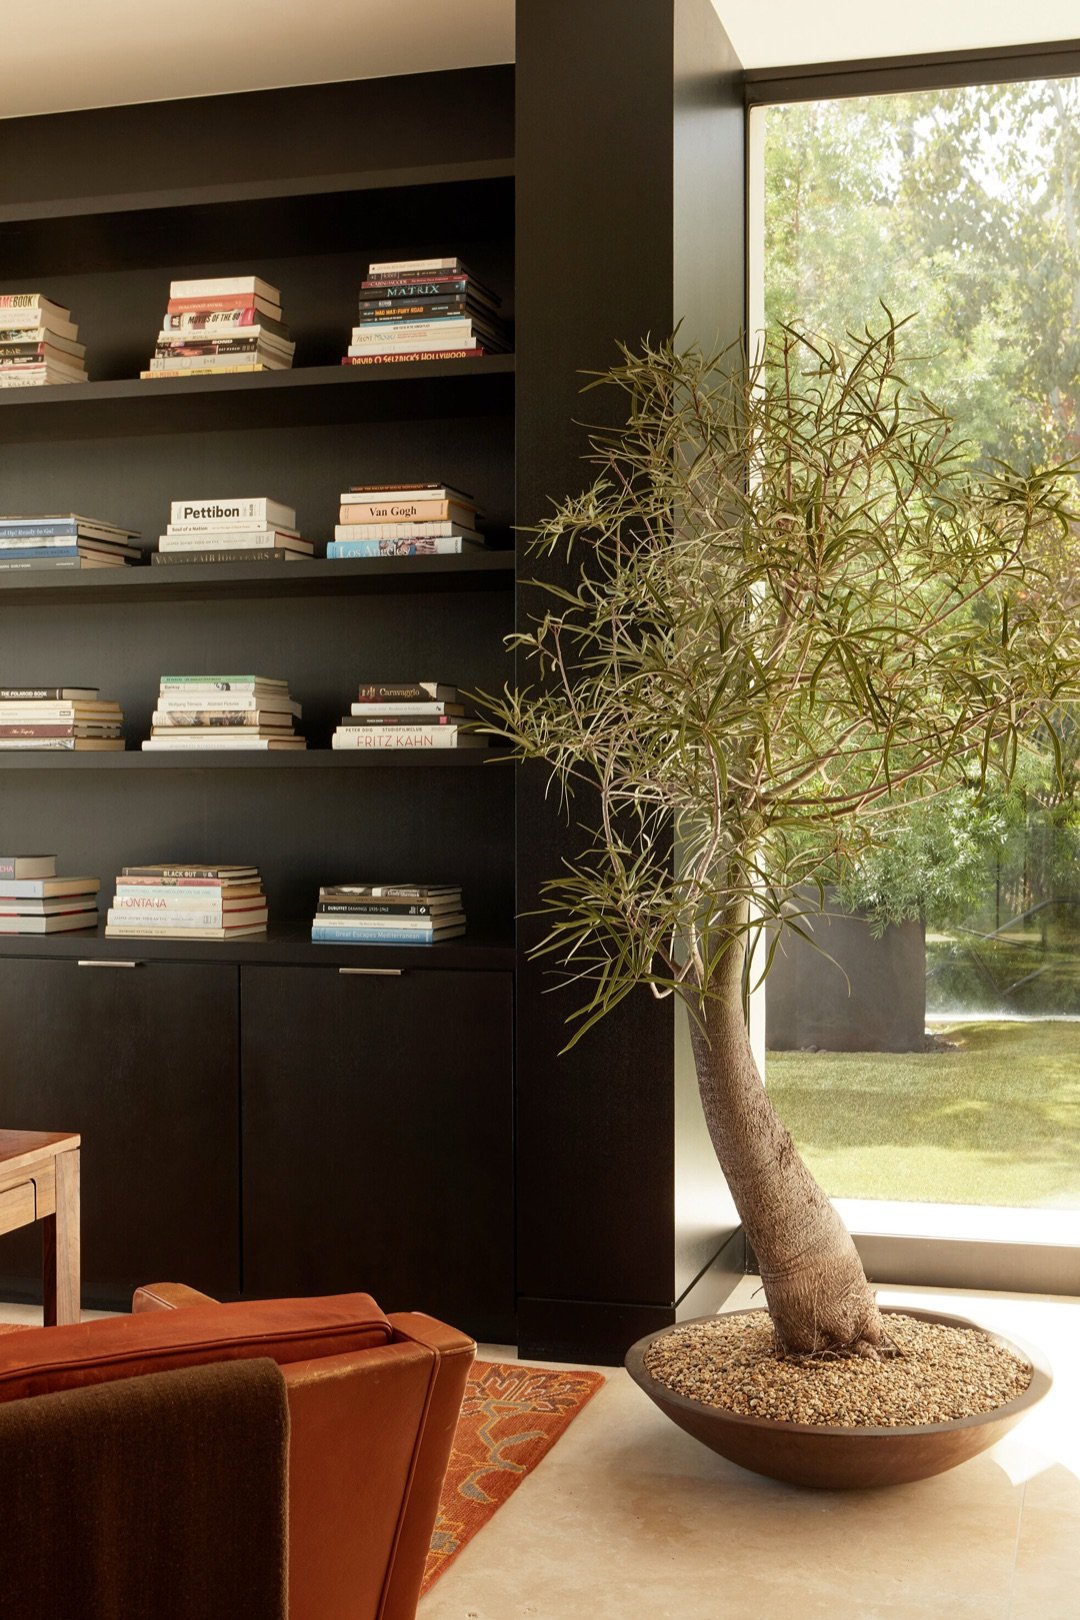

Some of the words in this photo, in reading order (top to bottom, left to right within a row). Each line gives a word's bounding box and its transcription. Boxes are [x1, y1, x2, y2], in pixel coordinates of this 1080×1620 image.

[387, 285, 440, 297] MATRIX
[188, 314, 211, 324] MOVIES
[212, 314, 219, 322] OF
[220, 313, 232, 321] THE
[352, 357, 373, 365] DAVID
[374, 356, 382, 364] O
[383, 353, 419, 363] SELZNICK'S
[421, 351, 466, 361] HOLLYWOOD
[184, 506, 240, 519] Pettibon
[369, 507, 388, 517] Van
[390, 506, 417, 517] Gogh
[340, 546, 362, 557] Los
[364, 544, 411, 557] Angeles
[379, 688, 420, 697] Caravaggio
[357, 735, 392, 748] FRITZ
[396, 735, 433, 747] KAHN
[120, 898, 167, 908] FONTANA
[353, 930, 377, 939] Escapes
[378, 930, 420, 938] Mediterranean
